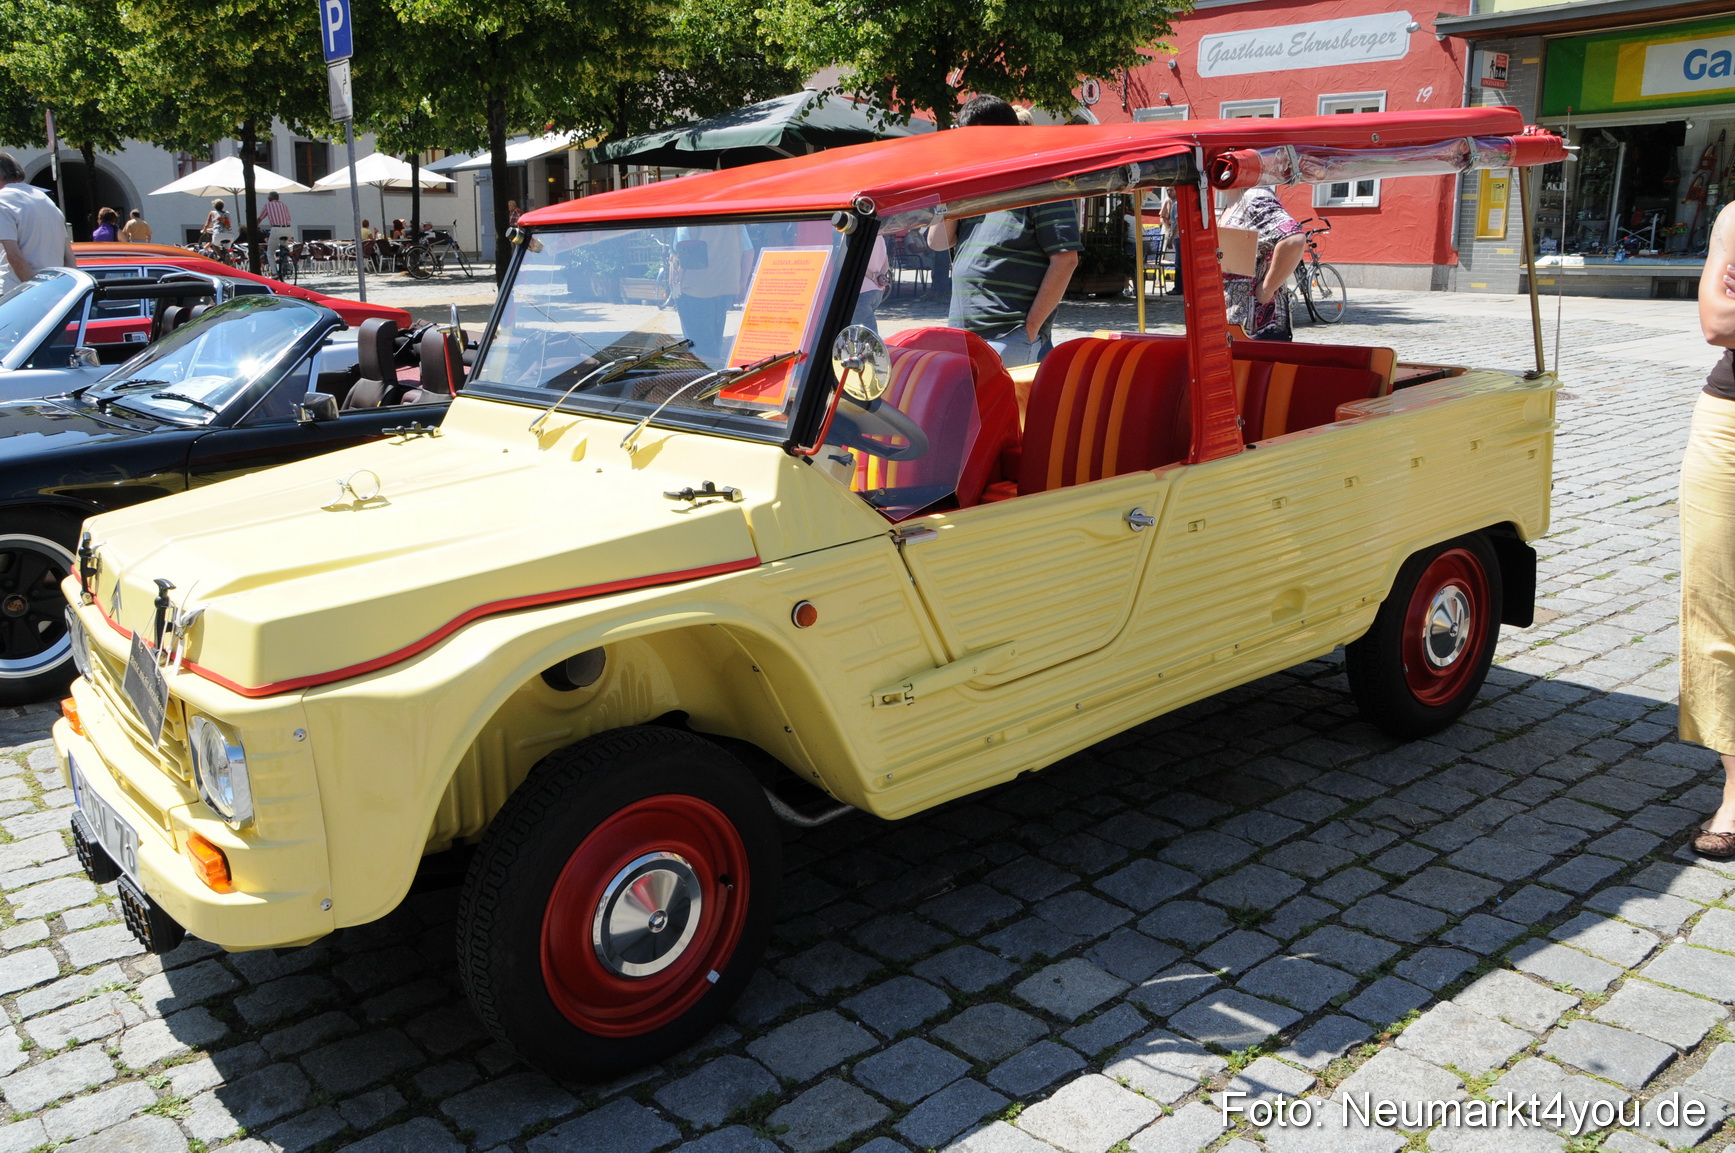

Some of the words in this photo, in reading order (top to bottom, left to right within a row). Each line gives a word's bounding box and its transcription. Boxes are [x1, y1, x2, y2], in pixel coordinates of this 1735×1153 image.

[326, 0, 343, 52] P
[1207, 38, 1283, 71] Gasthaus
[1287, 28, 1397, 57] Ehrnsberger
[1683, 48, 1735, 80] Ga
[1415, 86, 1433, 103] 19
[113, 814, 136, 876] 76
